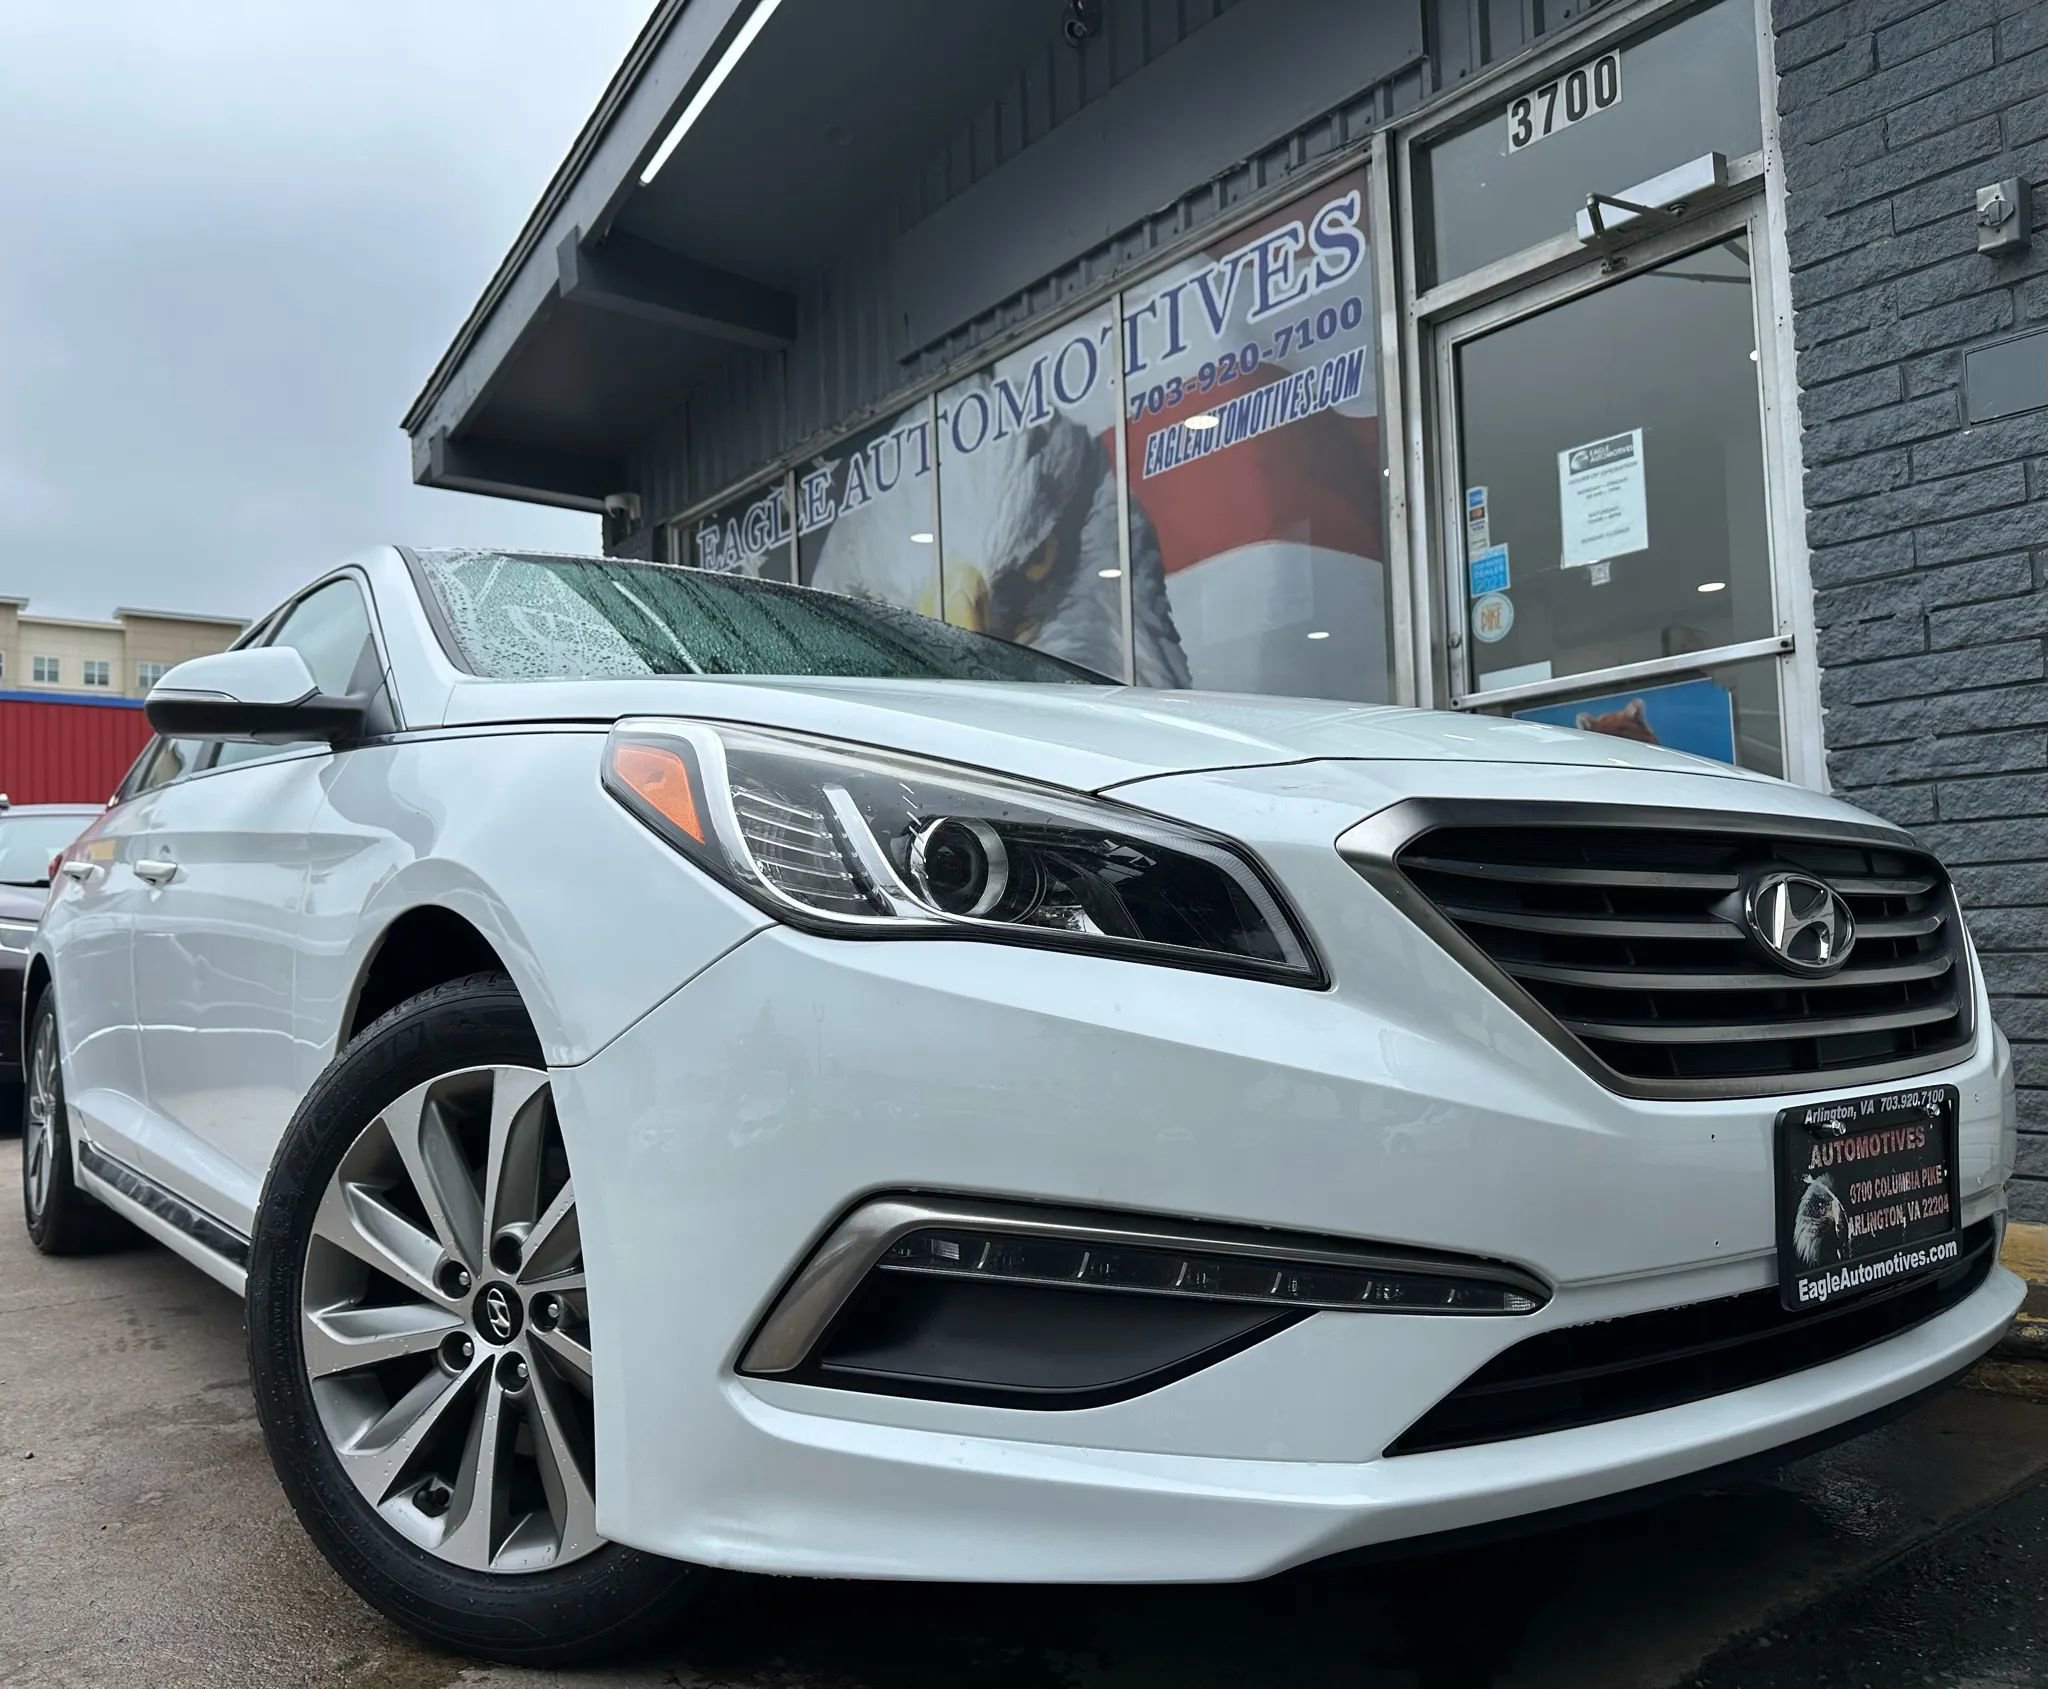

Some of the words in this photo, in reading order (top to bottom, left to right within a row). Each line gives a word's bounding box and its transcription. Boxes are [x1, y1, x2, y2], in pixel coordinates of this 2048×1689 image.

[1511, 54, 1617, 148] 3700
[697, 466, 836, 573] EAGLE
[837, 190, 1367, 519] AUTOMOTIVES
[1130, 296, 1363, 423] 703-920-7100
[1143, 346, 1367, 479] EAGLEAUTOMOTIVES.COM
[1804, 1105, 1856, 1124] Arlington,
[1860, 1099, 1875, 1116] VA
[1880, 1088, 1945, 1113] 703.920.7100
[1809, 1124, 1926, 1170] AUTOMOTIVES
[1874, 1169, 1920, 1199] COLUMBIA
[1922, 1164, 1943, 1188] PIKE
[1907, 1200, 1921, 1222] VA
[1922, 1193, 1949, 1218] 22204
[1798, 1239, 1958, 1302] EagleAutomotives.com
